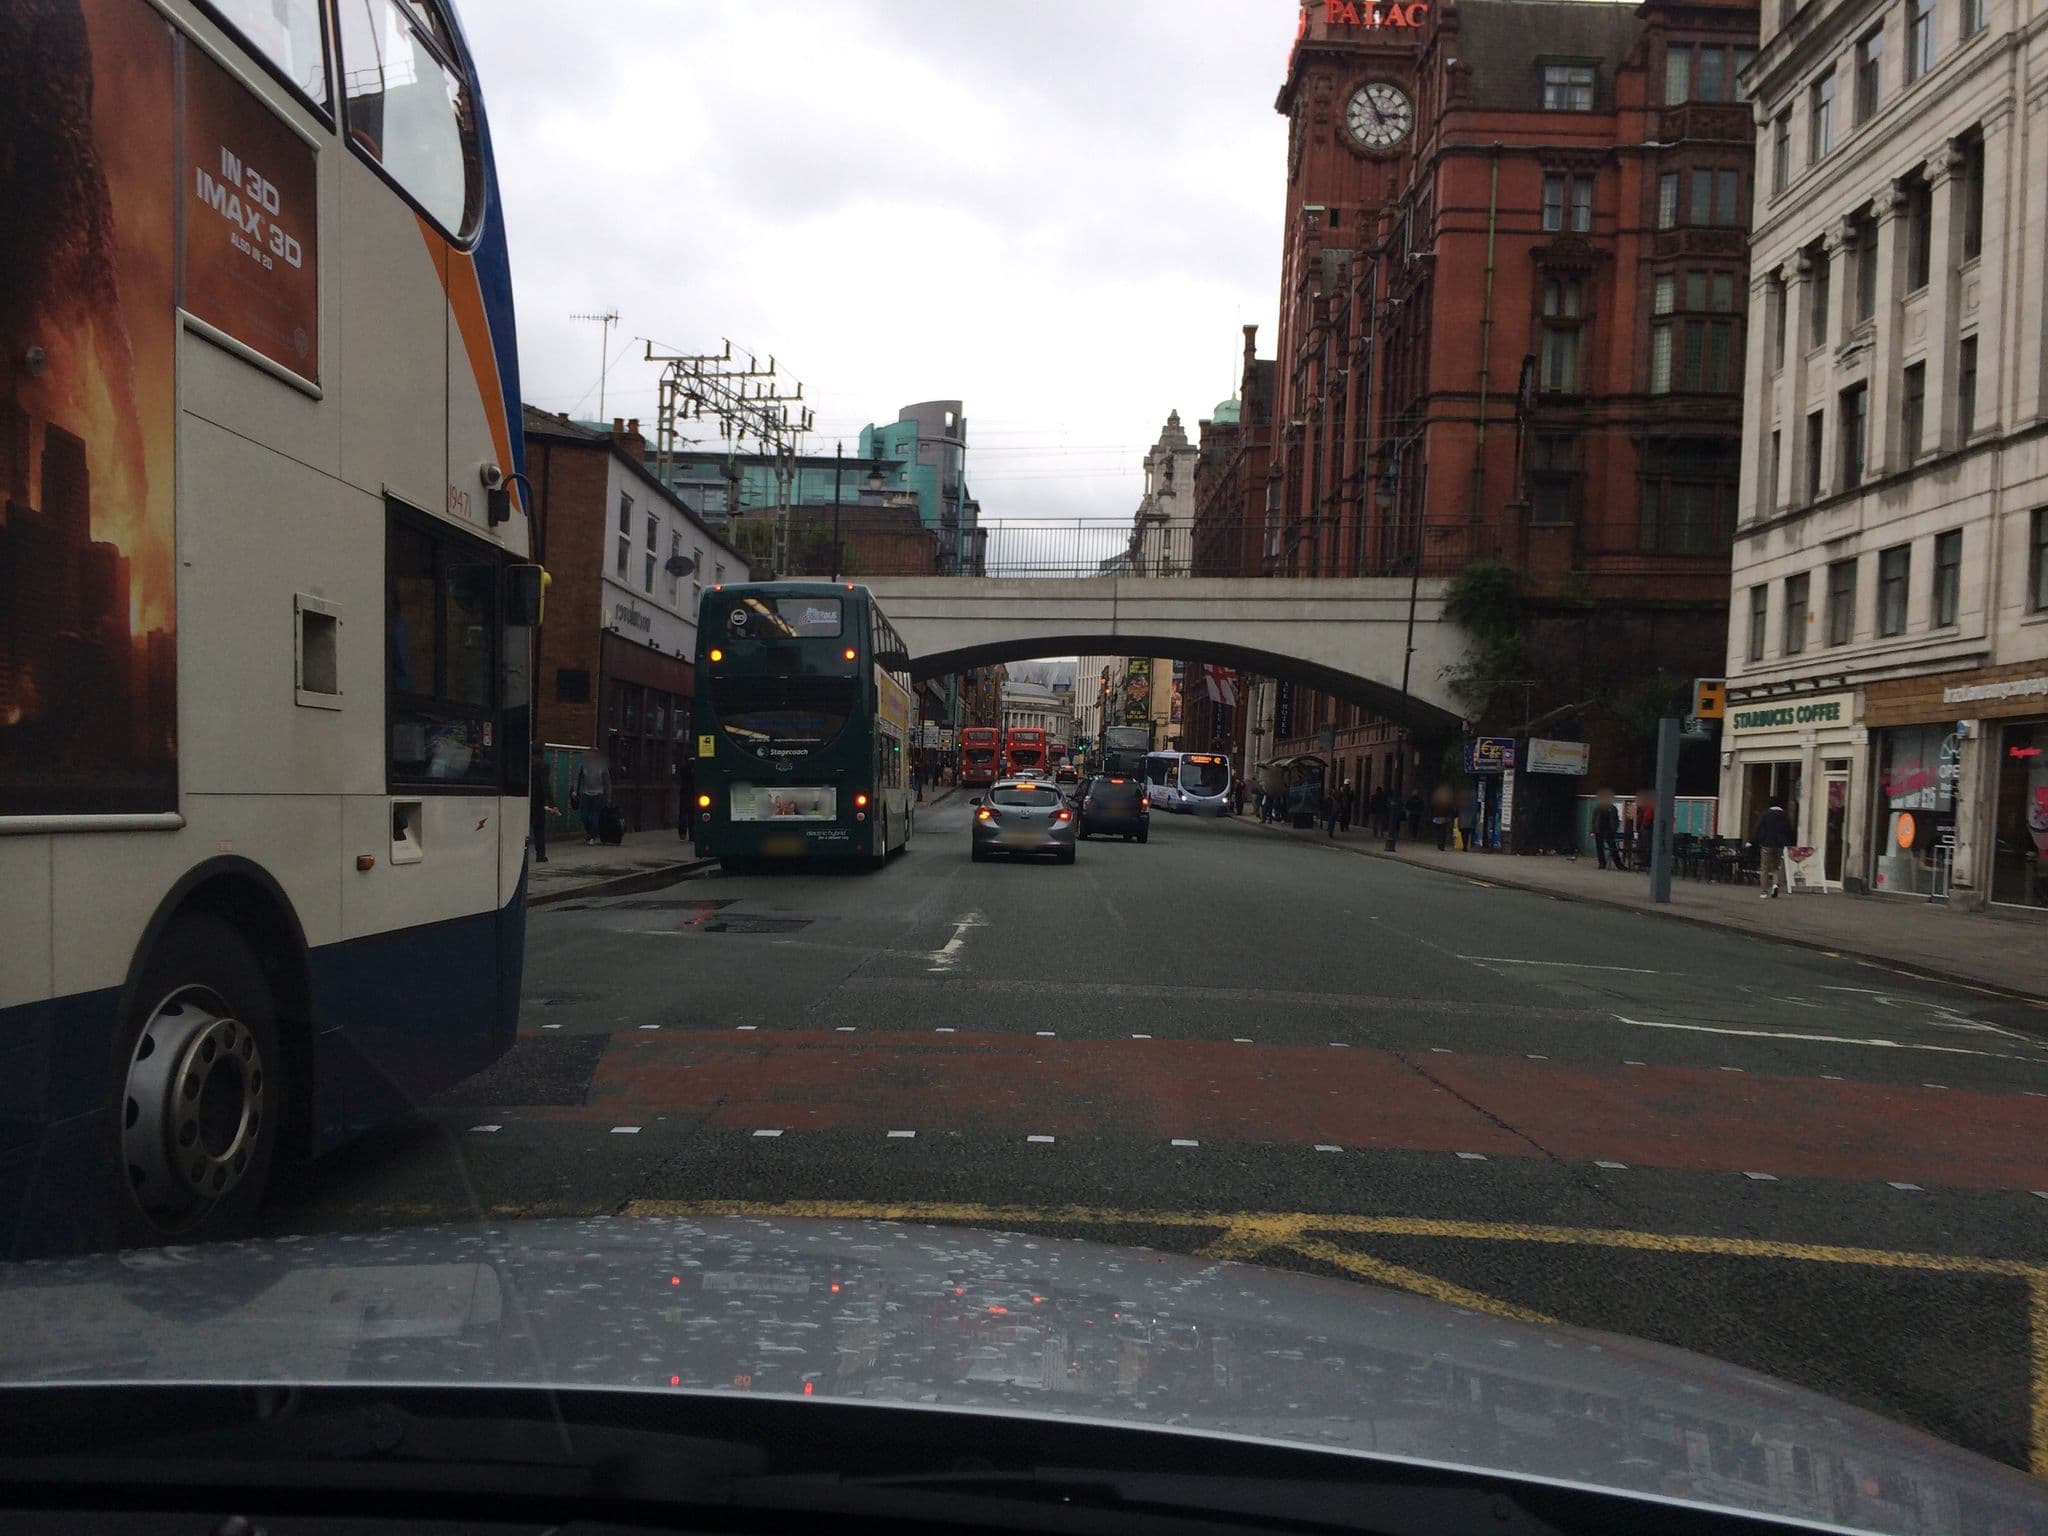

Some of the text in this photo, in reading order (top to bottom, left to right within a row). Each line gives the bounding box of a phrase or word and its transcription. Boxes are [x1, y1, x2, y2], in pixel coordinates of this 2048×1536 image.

[1324, 0, 1429, 28] PALAC
[220, 144, 281, 217] IN 3D
[196, 166, 303, 269] IMAX 3D
[230, 232, 251, 256] ALSO
[1733, 702, 1841, 729] STARBUCKS COFFEE
[770, 748, 808, 757] Stagecoach
[1939, 764, 1961, 778] OPE
